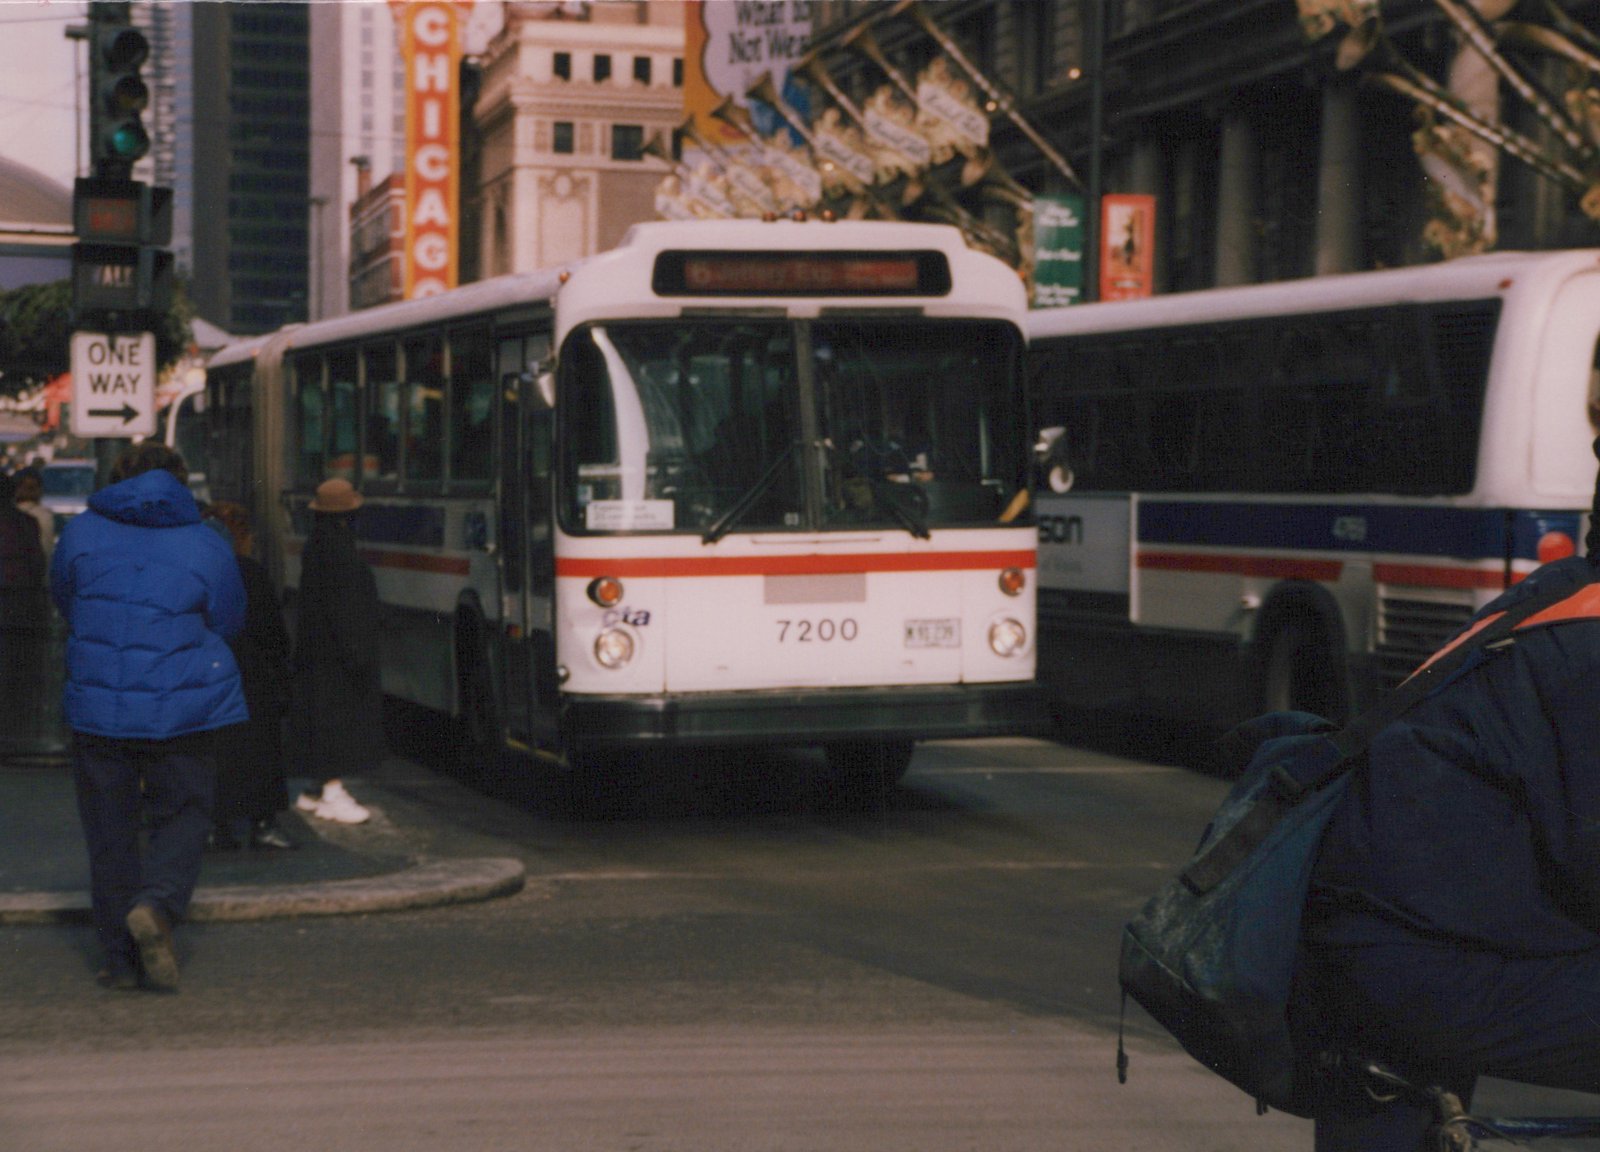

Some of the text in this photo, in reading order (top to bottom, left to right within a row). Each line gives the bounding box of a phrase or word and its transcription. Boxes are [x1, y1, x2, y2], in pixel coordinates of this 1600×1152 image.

[729, 32, 761, 63] Not
[88, 342, 141, 366] ONE
[89, 374, 142, 395] WAY
[776, 618, 858, 642] 7200
